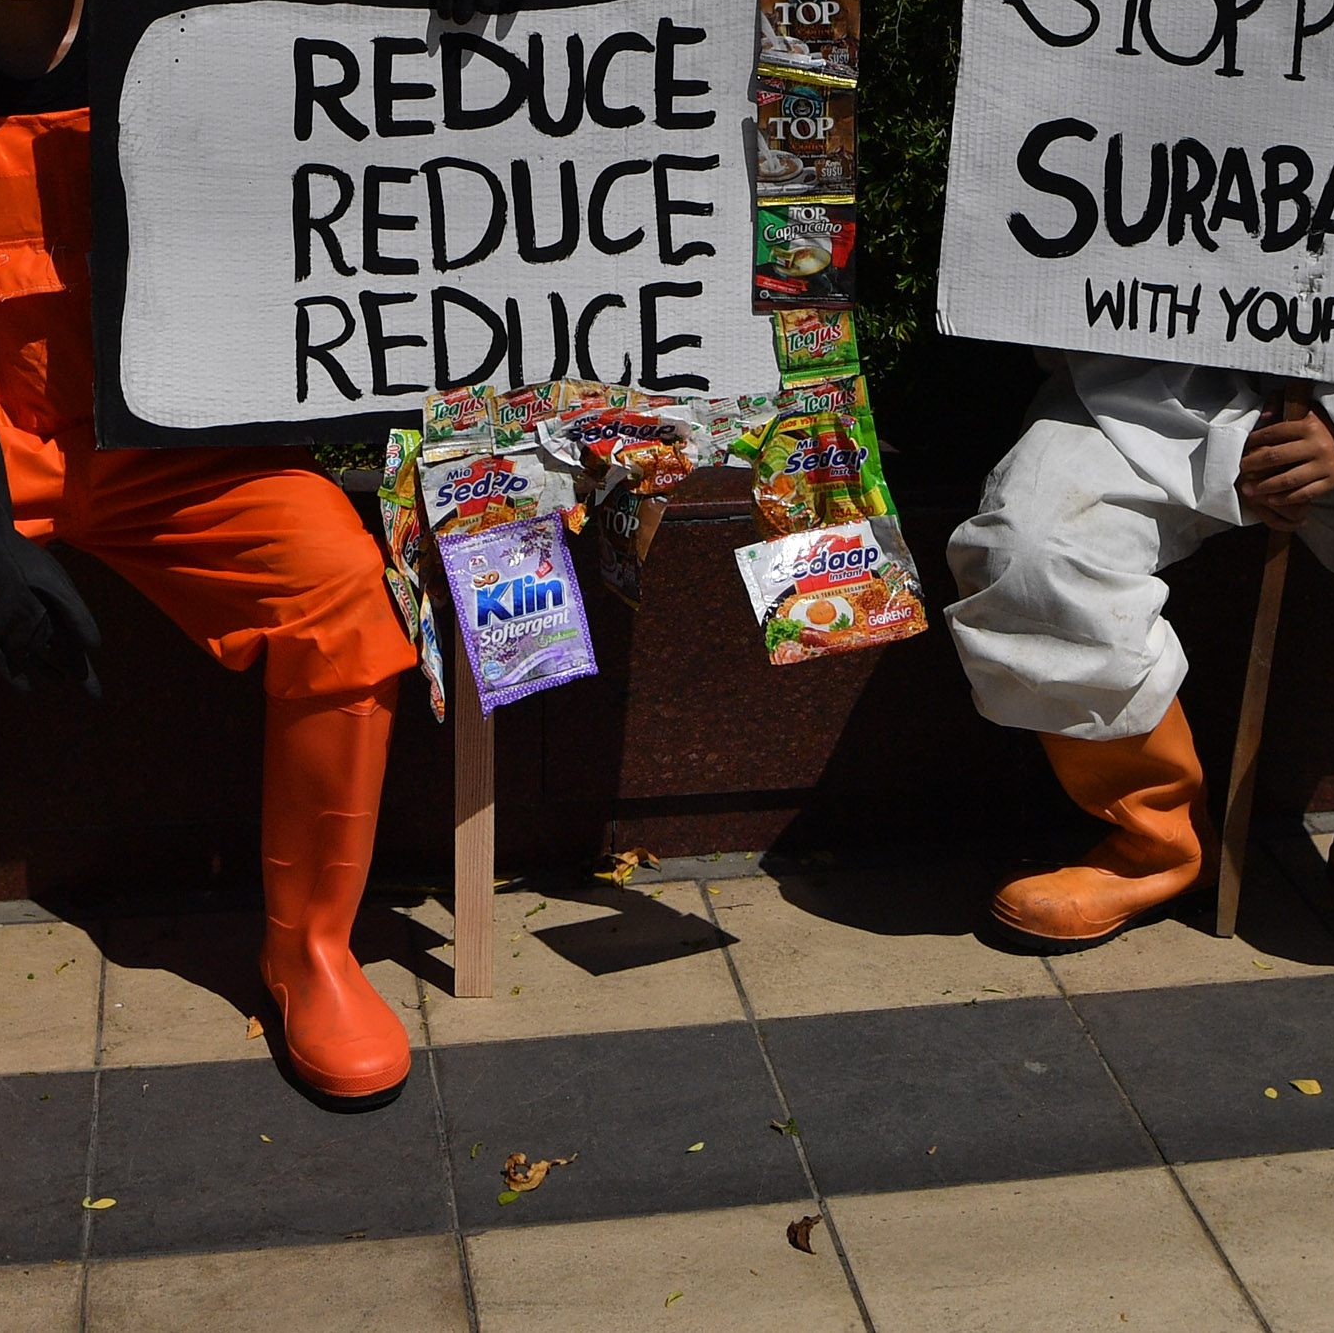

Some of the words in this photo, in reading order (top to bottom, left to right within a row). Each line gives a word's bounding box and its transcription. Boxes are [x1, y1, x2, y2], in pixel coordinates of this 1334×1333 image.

[774, 1, 840, 25] TOP
[828, 54, 849, 64] SUSU
[293, 18, 716, 142] REDUCE
[769, 117, 834, 140] TOP
[821, 167, 843, 177] SUSU
[292, 154, 720, 283] REDUCE
[790, 207, 828, 222] TOP
[763, 219, 843, 242] Cappuccino
[1085, 278, 1201, 339] WITH
[295, 282, 709, 403] REDUCE
[569, 421, 676, 443] Sedaap
[796, 438, 819, 451] Mie
[446, 468, 472, 482] Mie
[604, 508, 640, 539] TOP
[829, 569, 863, 582] Instant
[476, 575, 564, 628] Klin
[868, 607, 912, 626] GORENG
[480, 610, 571, 647] Softergent
